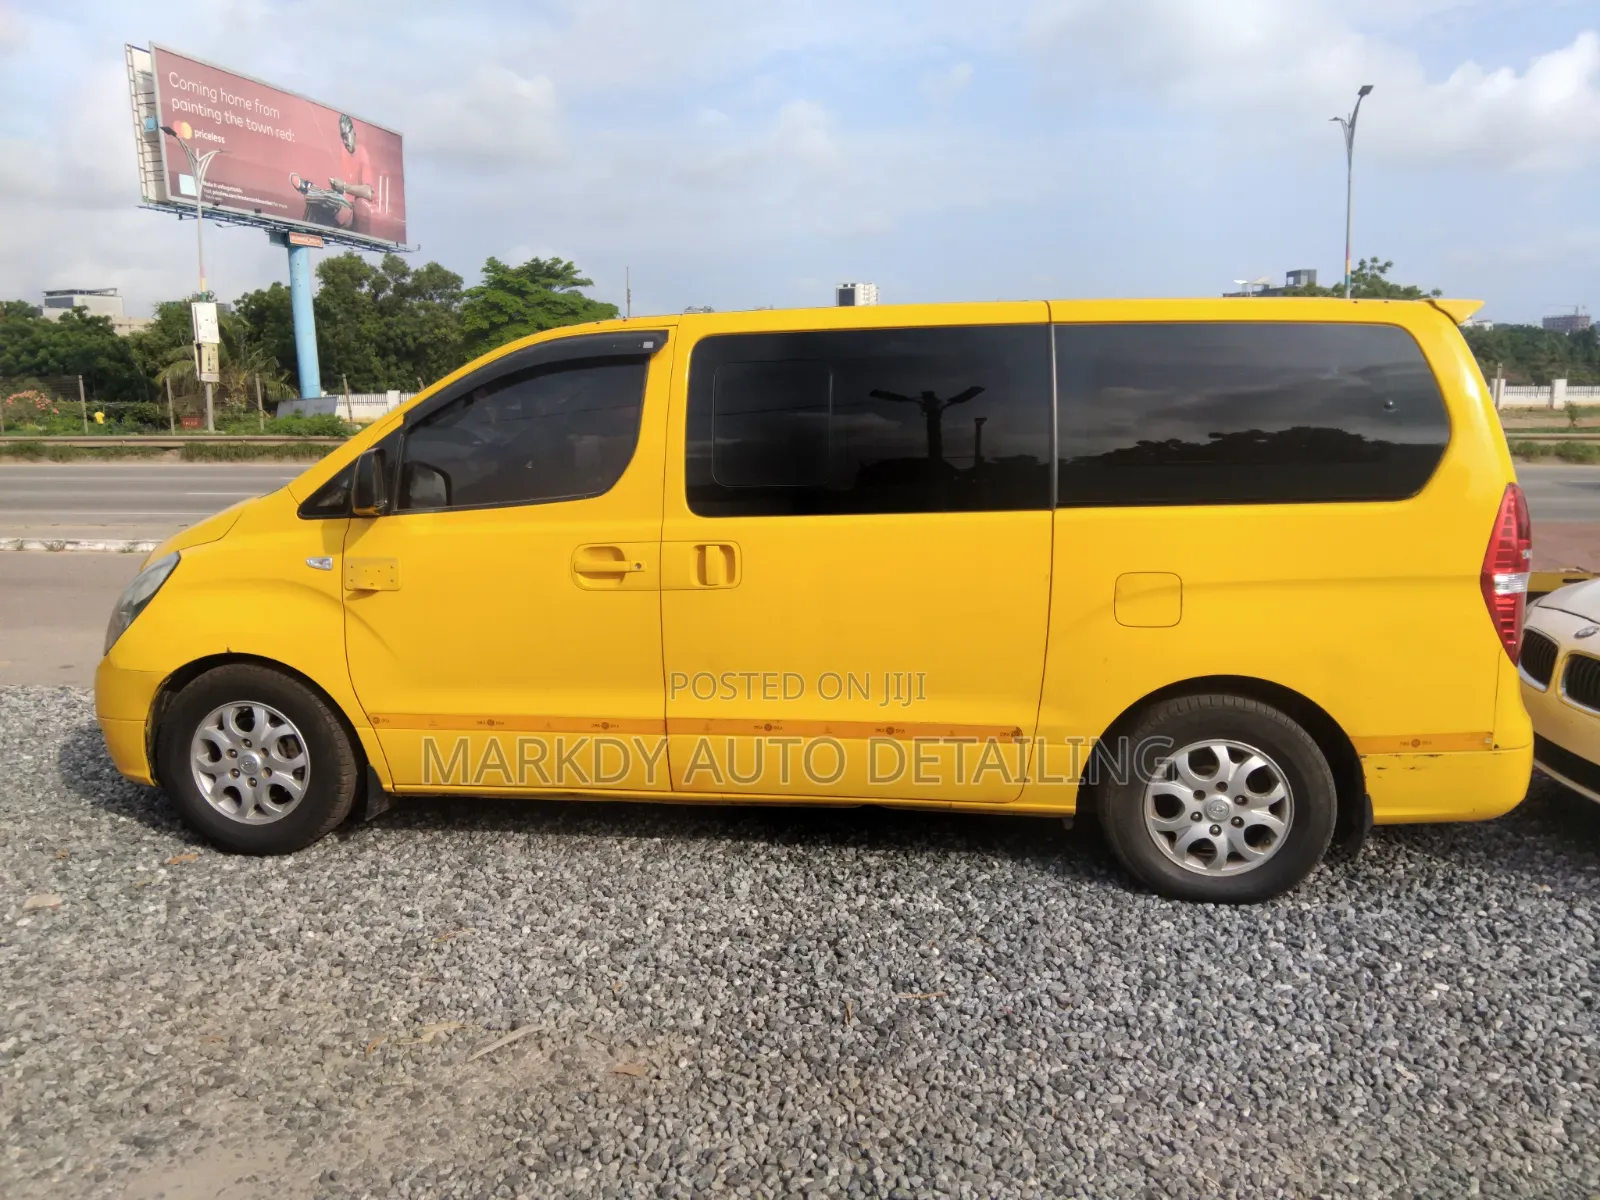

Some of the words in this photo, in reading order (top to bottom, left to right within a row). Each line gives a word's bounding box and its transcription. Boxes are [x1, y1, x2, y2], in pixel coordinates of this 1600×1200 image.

[168, 71, 217, 103] Coming
[220, 87, 252, 110] home
[254, 98, 280, 120] from
[171, 98, 222, 125] painting
[224, 110, 244, 128] the
[245, 117, 274, 137] town
[275, 128, 296, 143] red:
[194, 128, 226, 144] priceless
